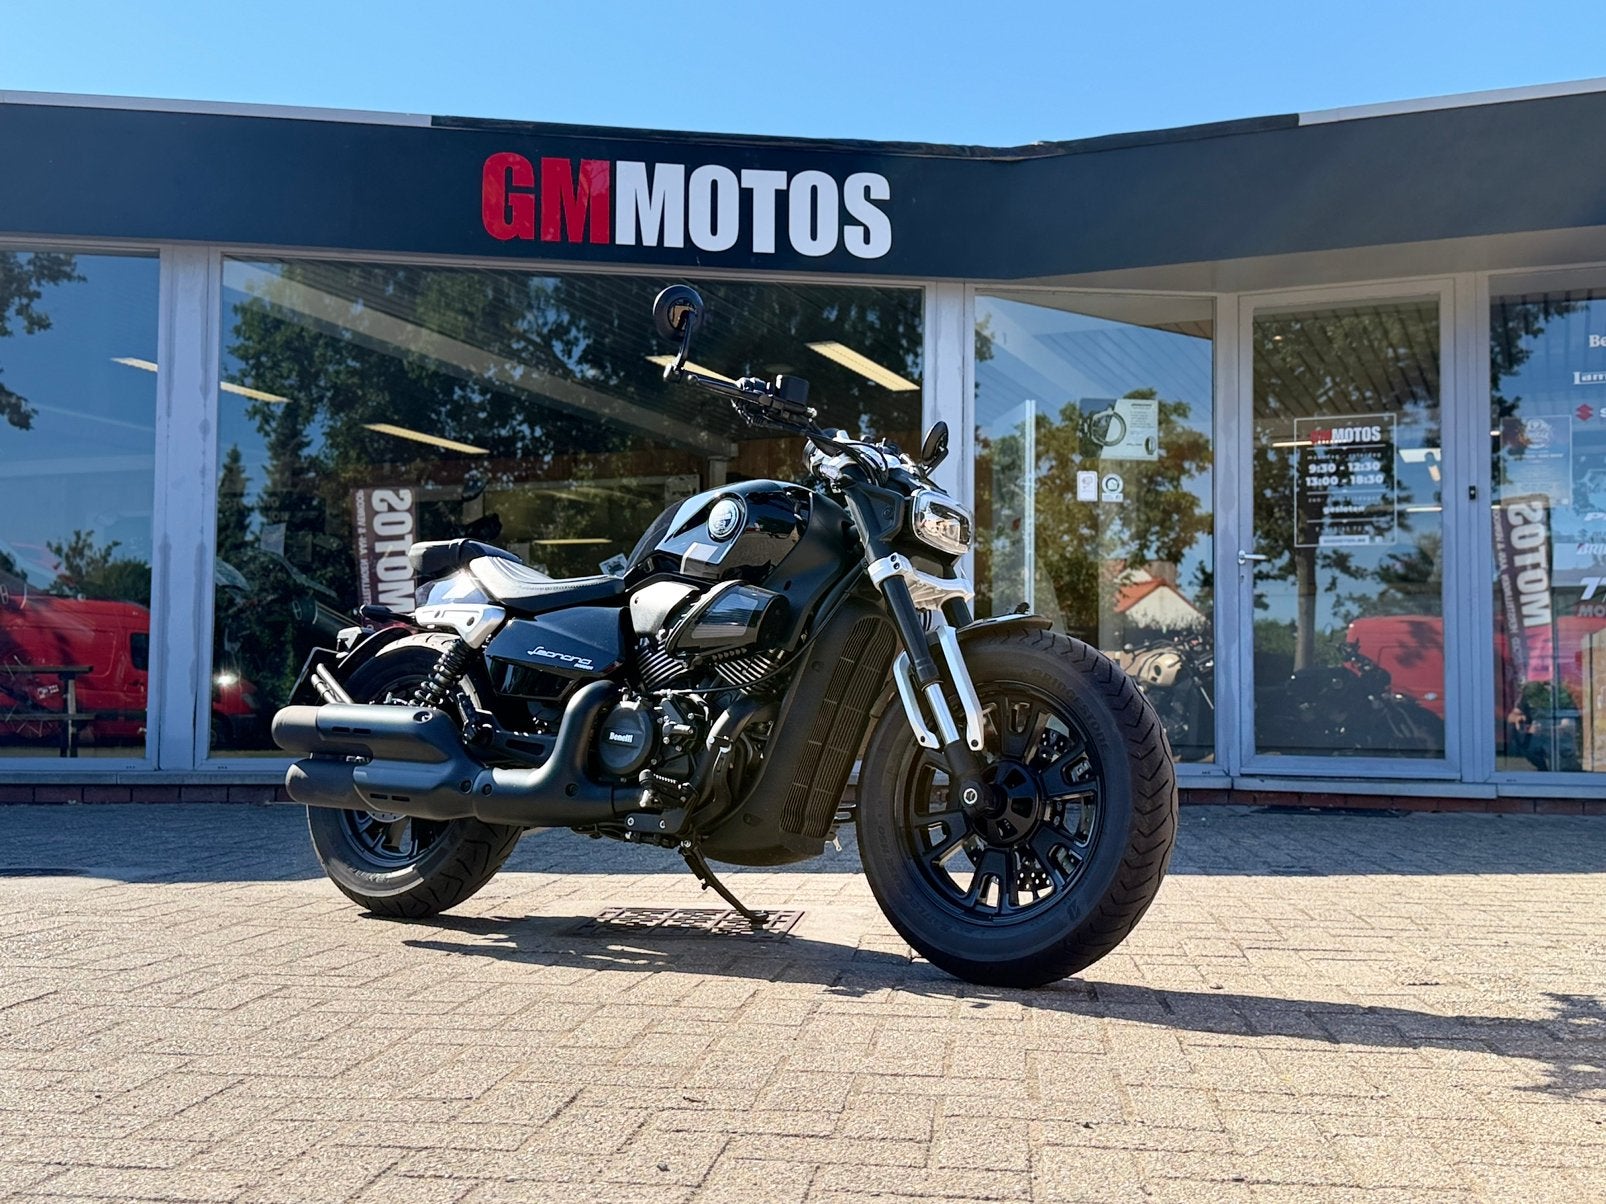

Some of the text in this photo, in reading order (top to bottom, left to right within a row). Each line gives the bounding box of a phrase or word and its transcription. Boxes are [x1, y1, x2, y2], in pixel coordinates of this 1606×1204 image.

[481, 151, 893, 260] GMMOTOS
[1308, 463, 1337, 474] 9:30
[1347, 461, 1381, 472] 12:30
[1305, 475, 1339, 487] 13:00
[1349, 474, 1384, 485] 18:30
